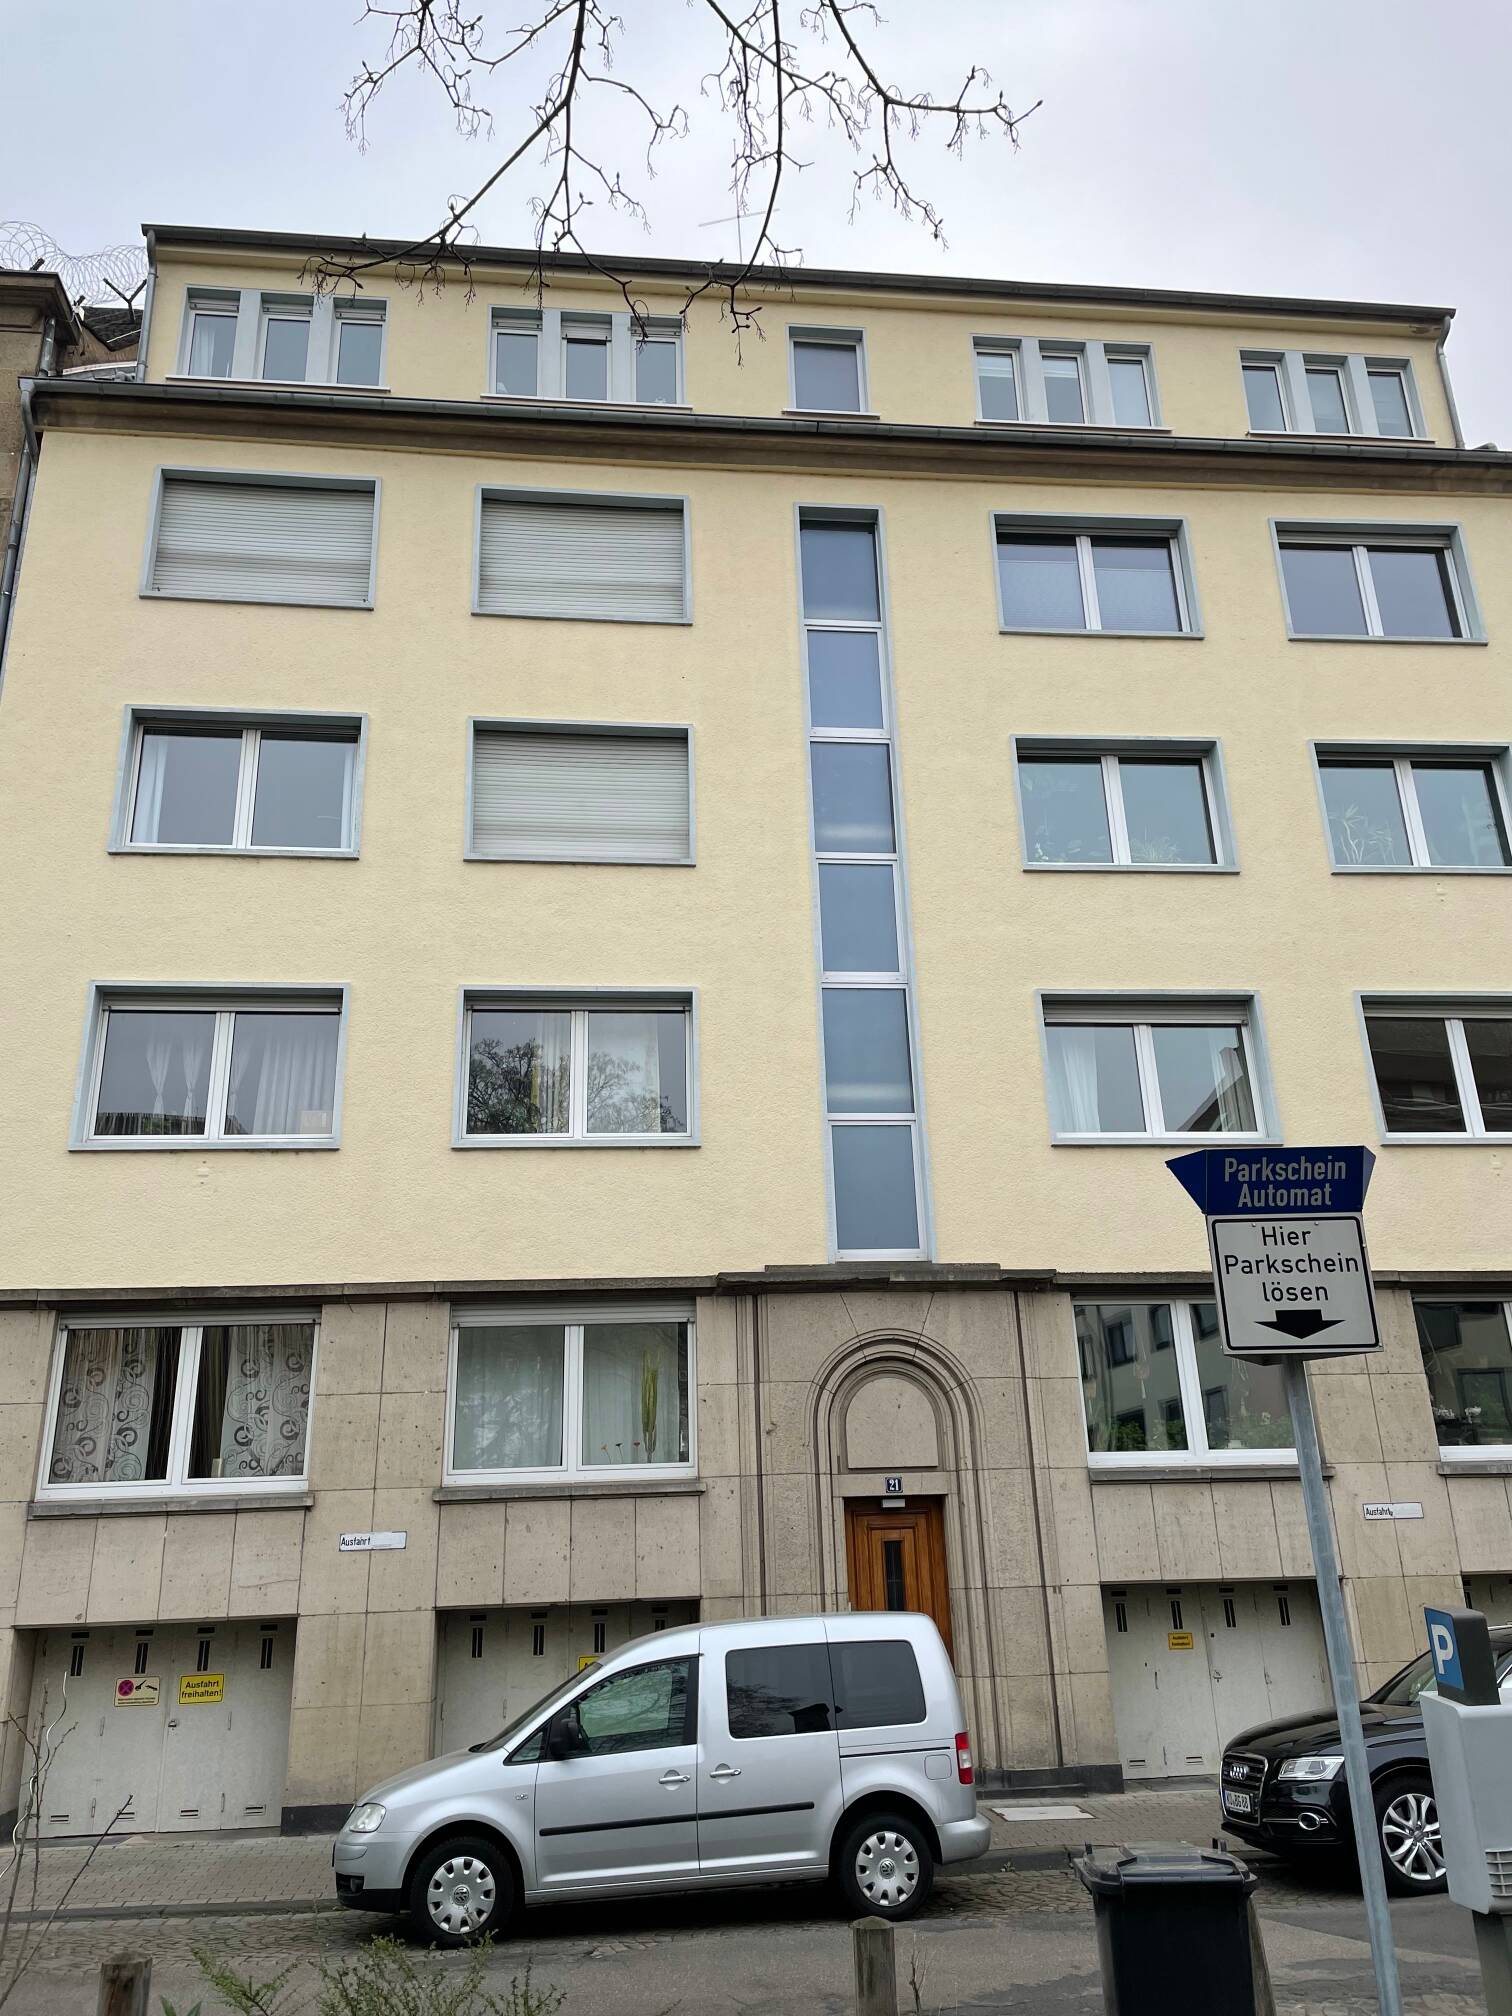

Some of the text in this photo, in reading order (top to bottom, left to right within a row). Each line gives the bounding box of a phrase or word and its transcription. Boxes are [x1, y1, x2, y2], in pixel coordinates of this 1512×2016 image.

[1223, 1155, 1346, 1182] Parkschein
[1237, 1183, 1333, 1208] Automat
[1261, 1226, 1312, 1246] Hier
[1223, 1252, 1359, 1275] Parkschein
[1261, 1281, 1329, 1302] lösen
[888, 1478, 899, 1491] 21
[1365, 1507, 1391, 1517] Ausfahrt
[340, 1536, 371, 1547] Ausfahrt
[1430, 1623, 1454, 1675] P
[181, 1690, 223, 1698] freihalten!
[185, 1680, 219, 1689] Ausfahrt
